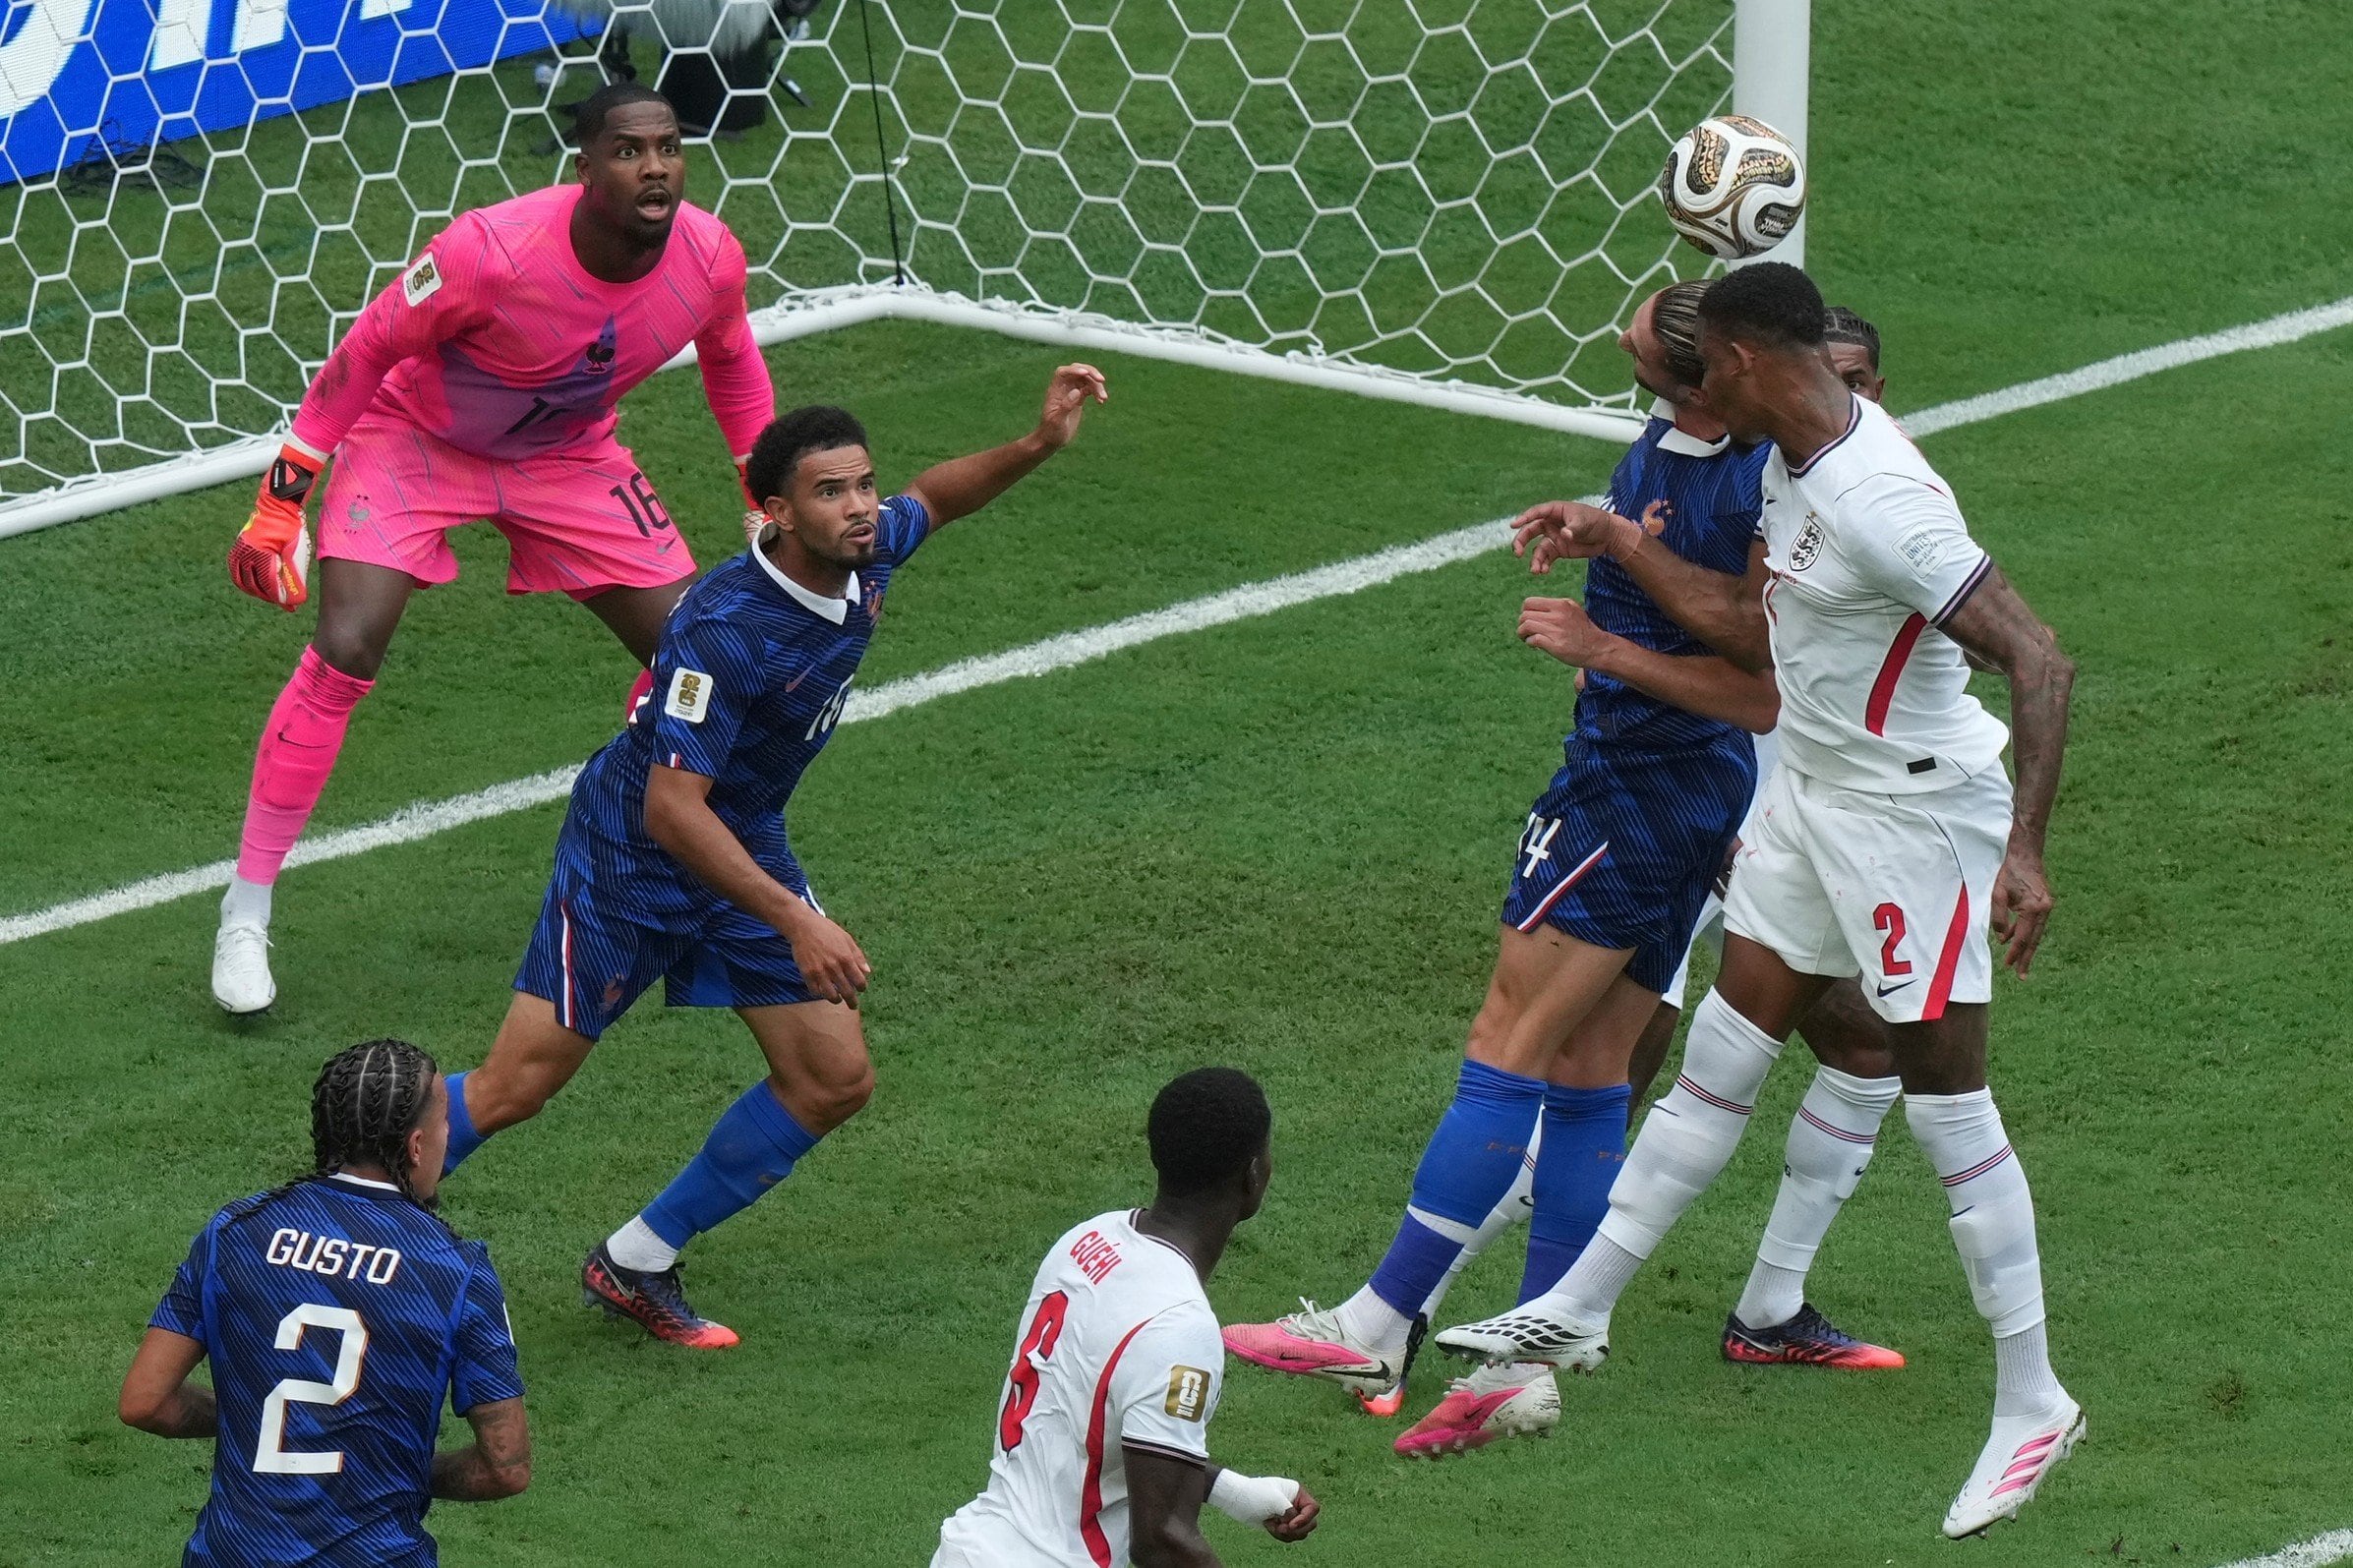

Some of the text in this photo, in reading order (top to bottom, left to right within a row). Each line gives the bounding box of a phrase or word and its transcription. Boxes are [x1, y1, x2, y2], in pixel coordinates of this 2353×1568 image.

[610, 472, 672, 538] 16
[1900, 531, 1926, 552] FOOTBALL
[1906, 535, 1930, 559] UNITES
[1872, 902, 1913, 976] 2
[265, 1227, 401, 1285] GUSTO
[1069, 1230, 1123, 1286] GUÉHI
[253, 1303, 369, 1475] 2
